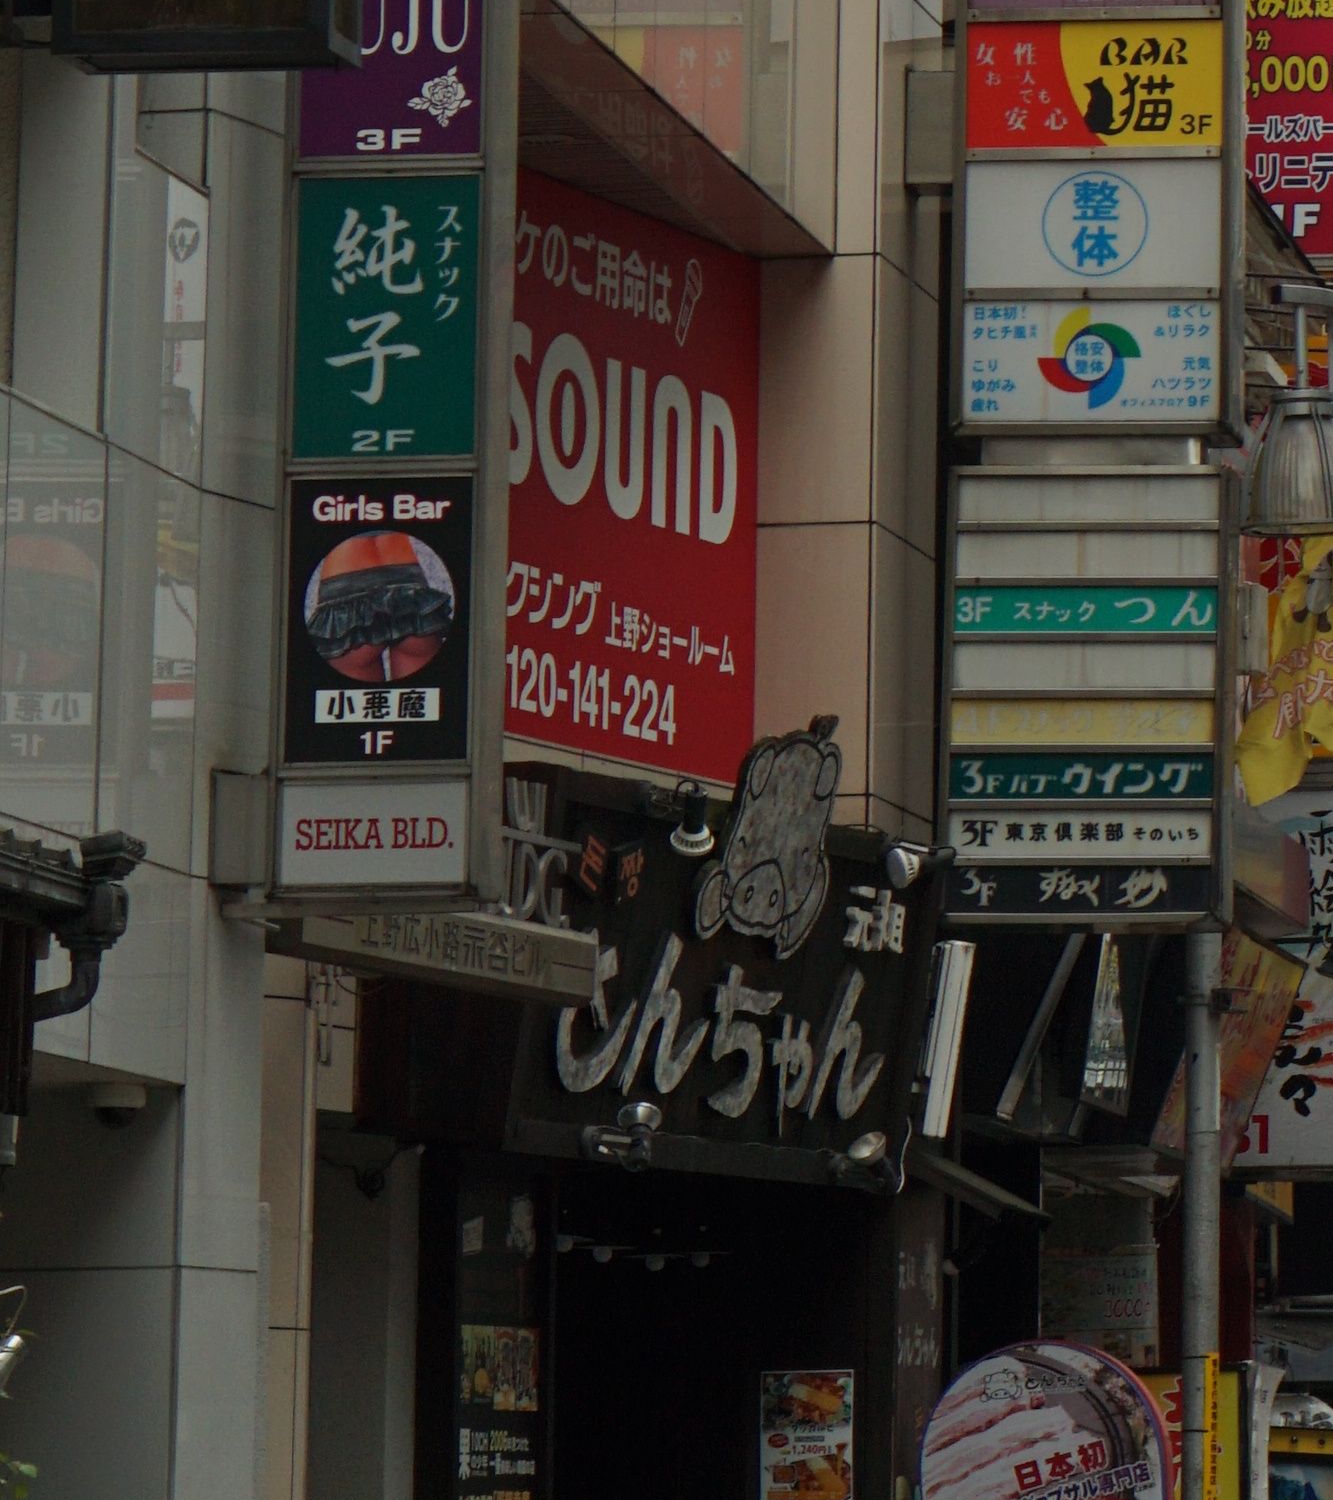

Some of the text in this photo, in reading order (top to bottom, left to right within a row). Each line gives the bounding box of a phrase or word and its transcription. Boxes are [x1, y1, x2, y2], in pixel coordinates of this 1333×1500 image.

[975, 40, 1037, 68] 女性
[1098, 36, 1189, 67] BAR
[1019, 86, 1052, 106] でも
[1119, 71, 1175, 134] 猫
[1004, 106, 1070, 133] 安心
[1179, 113, 1213, 136] 3F
[355, 128, 422, 150] 3F
[1071, 180, 1119, 269] 整体
[324, 203, 463, 406] 純子 スナック
[1167, 304, 1213, 319] ほぐし
[972, 359, 999, 374] こり
[1182, 356, 1212, 372] 元気
[971, 380, 1016, 393] ゆがみ
[350, 430, 416, 453] 2F
[312, 492, 452, 523] Girls Bar
[956, 590, 1213, 627] 3F スナック つん
[603, 599, 735, 676] 上野ショールーム
[325, 690, 438, 721] 小悪魔
[359, 731, 394, 757] 1F
[960, 760, 1004, 794] 3F
[1061, 761, 1203, 794] ウイング
[294, 817, 455, 851] SEIKA BLD.
[960, 819, 1199, 847] 3F 東京倶楽部 そのいち
[960, 867, 997, 907] 3F
[1012, 1437, 1109, 1494] 日本初
